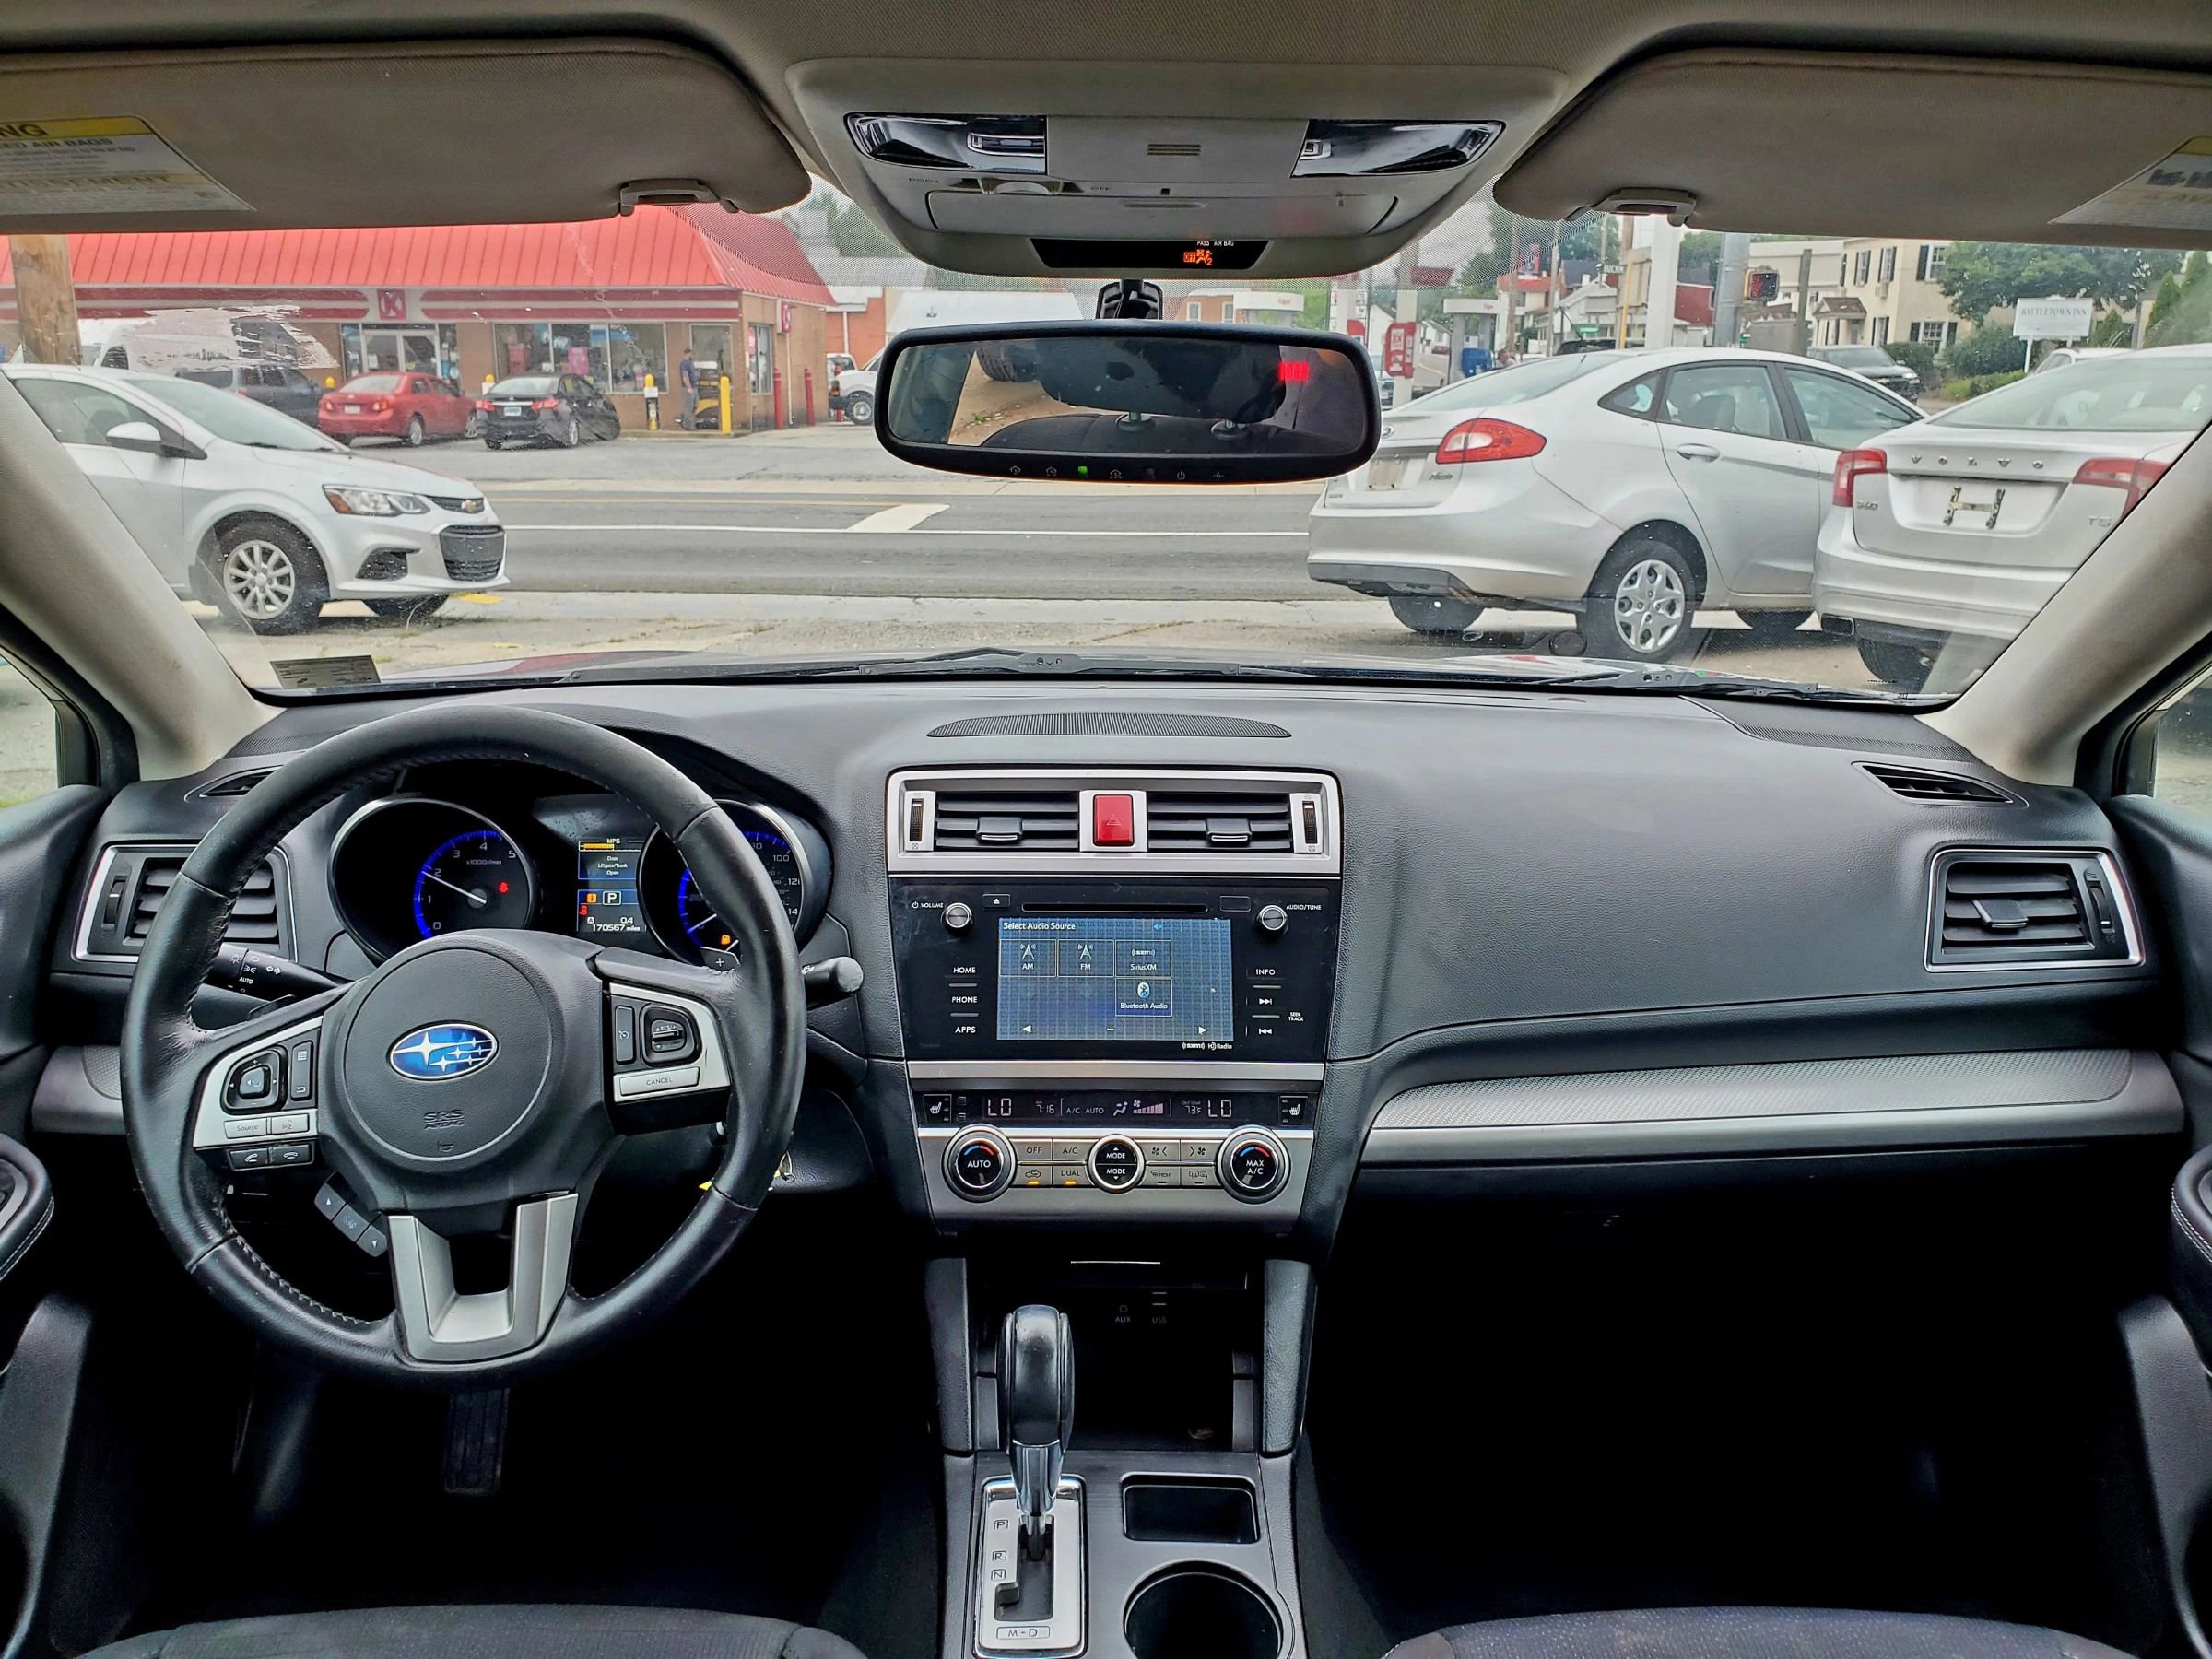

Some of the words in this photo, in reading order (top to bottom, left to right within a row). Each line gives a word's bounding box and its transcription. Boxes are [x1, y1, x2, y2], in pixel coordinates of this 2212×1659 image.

[1911, 455, 2044, 470] VOLVO
[479, 842, 488, 851] 4
[453, 849, 460, 858] 3
[508, 850, 516, 858] 5
[434, 868, 441, 877] 2
[608, 892, 618, 904] P
[433, 922, 441, 930] 0
[1003, 922, 1026, 930] Select
[1027, 922, 1050, 930] Audio
[1130, 963, 1157, 971] SiriusXM
[1255, 968, 1277, 976] INFO
[646, 1077, 674, 1086] CANCEL
[423, 1110, 465, 1122] SRS
[1026, 1147, 1042, 1155] OFF
[1062, 1147, 1078, 1155] A/C
[967, 1159, 992, 1169] AUTO
[1246, 1159, 1265, 1168] MAX
[1248, 1168, 1265, 1176] A/C
